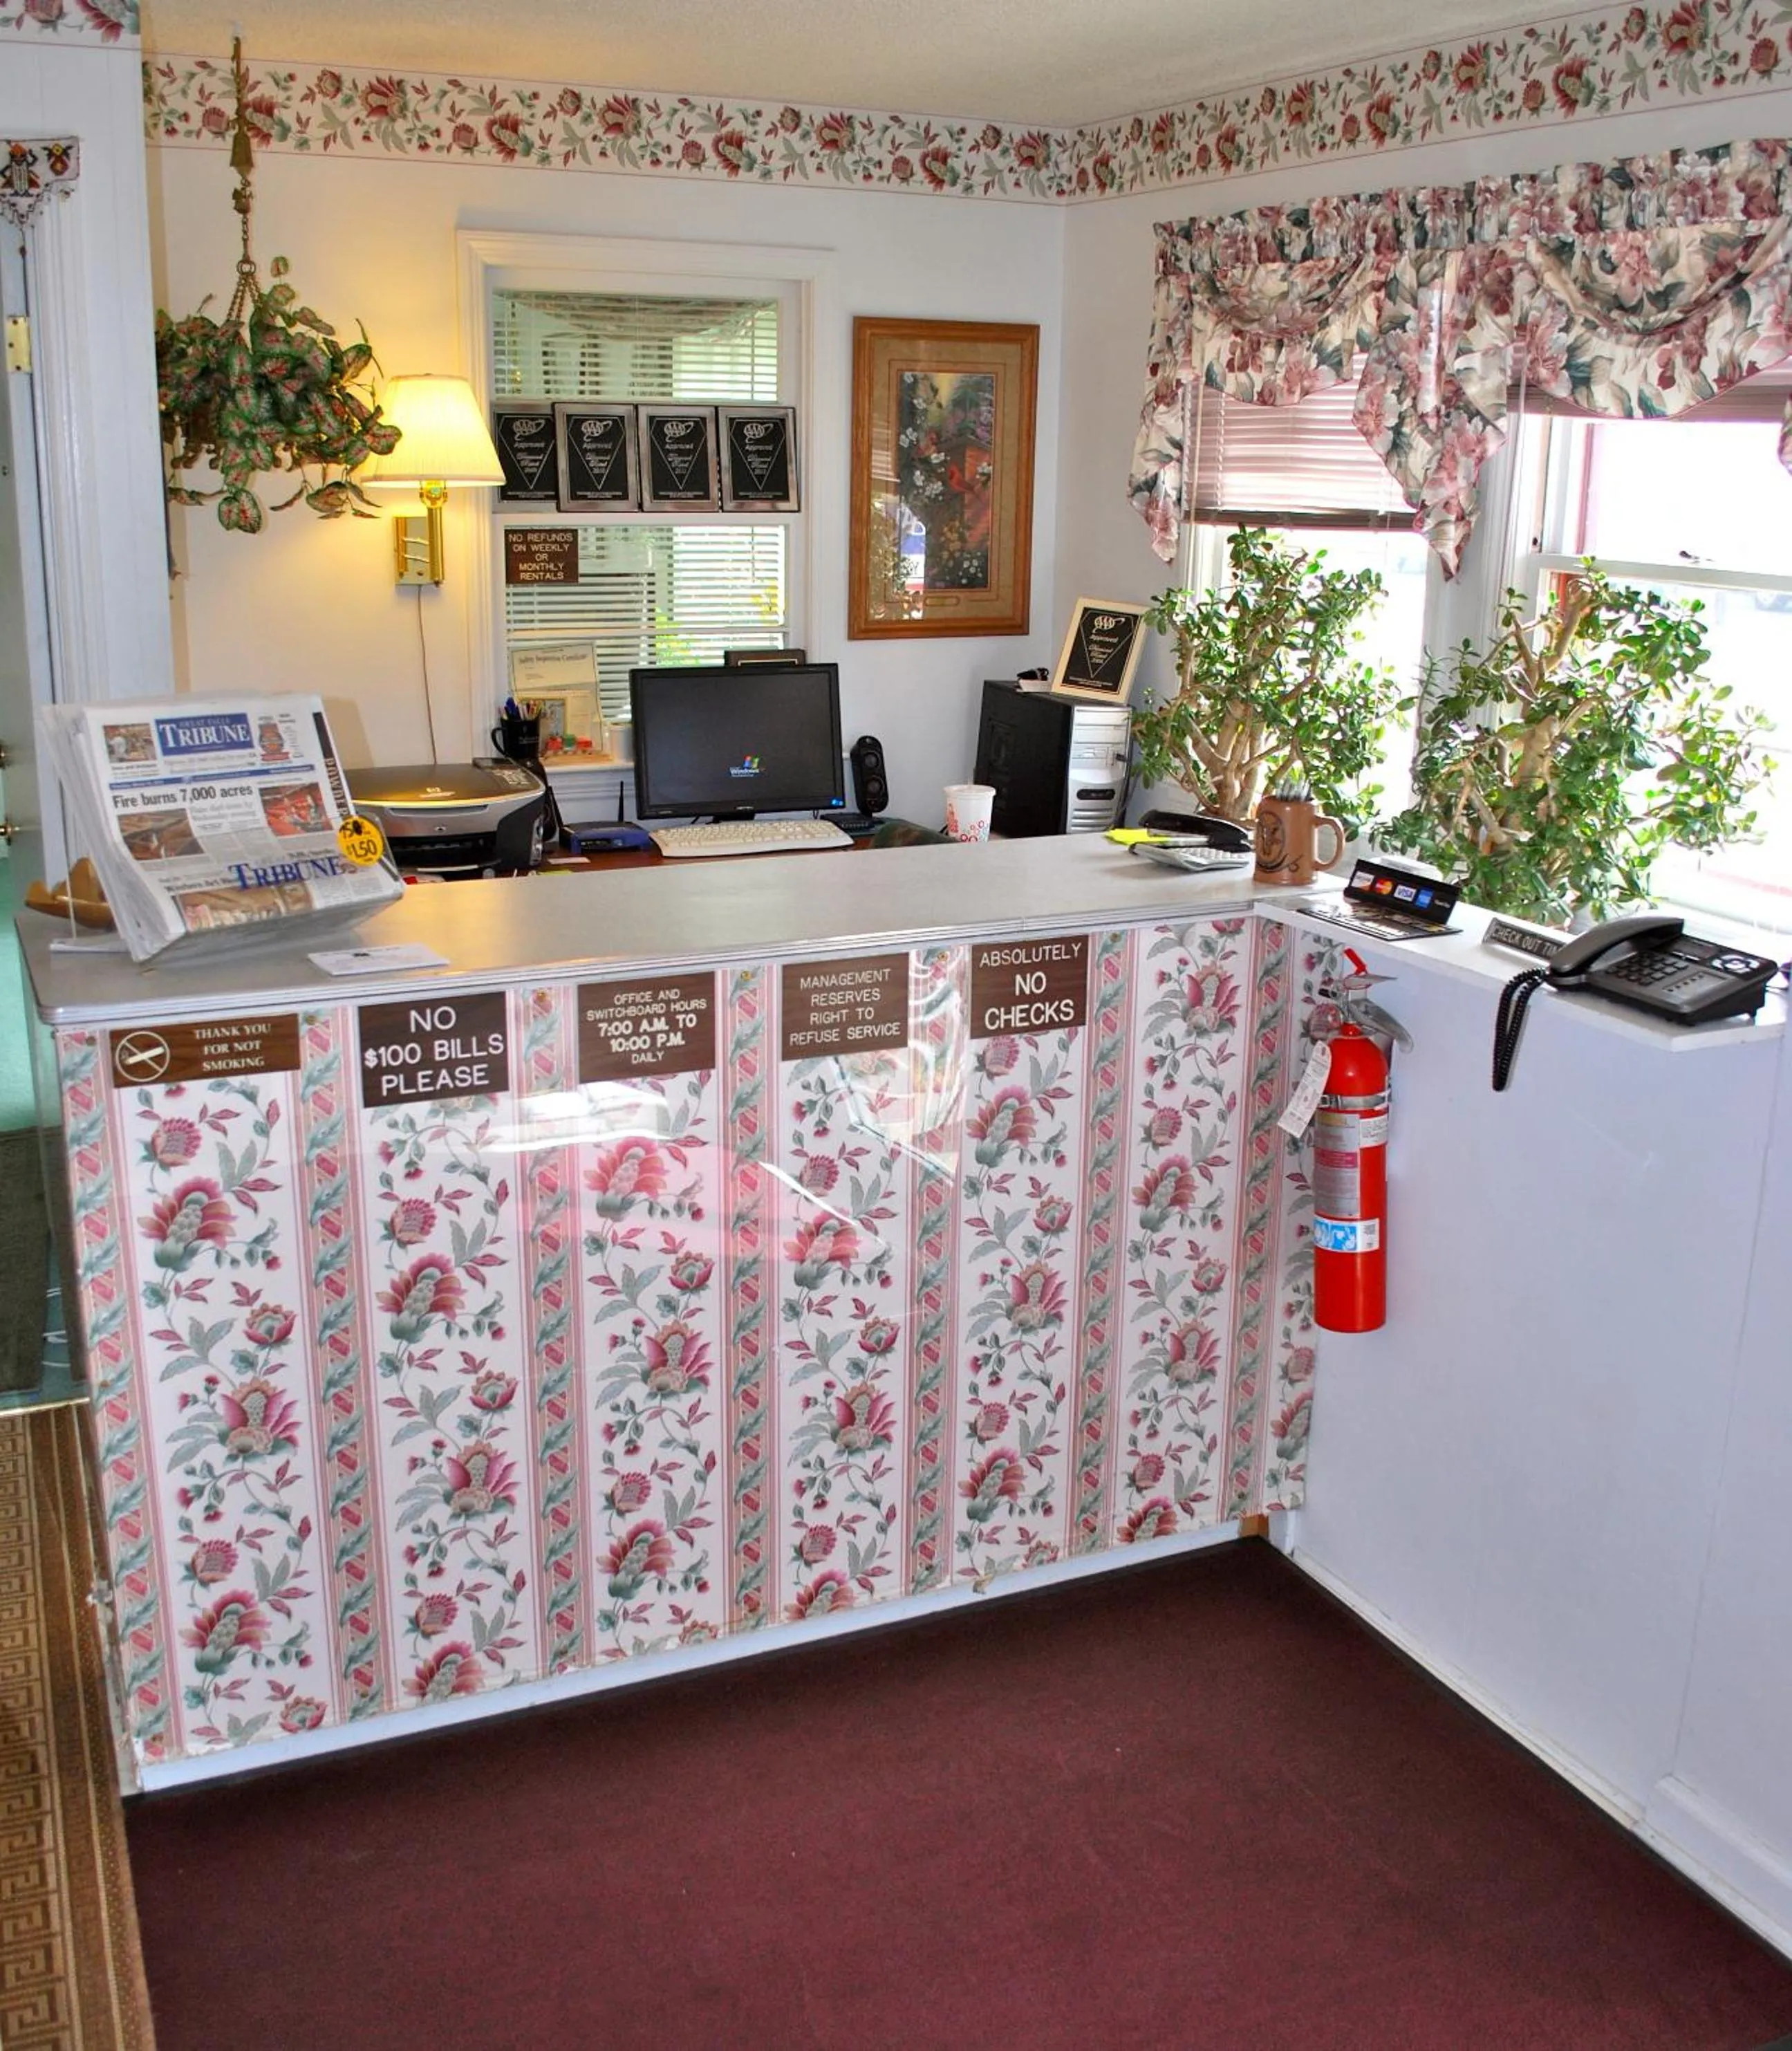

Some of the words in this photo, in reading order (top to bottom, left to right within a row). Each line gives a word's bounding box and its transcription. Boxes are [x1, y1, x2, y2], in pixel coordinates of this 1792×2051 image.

[508, 533, 523, 543] NO
[527, 532, 573, 542] REFUNDS
[512, 544, 527, 552] ON
[530, 543, 570, 552] WEEKLY
[519, 562, 564, 571] MONTHLY
[535, 553, 548, 562] OR
[520, 571, 564, 580] RENTALS
[159, 723, 251, 748] TRIBUNE
[113, 795, 138, 809] Fire
[141, 790, 177, 806] burns
[179, 786, 216, 805] 7,000
[221, 786, 254, 797] acres
[228, 856, 342, 891] TRIBUNE
[1491, 926, 1522, 945] CHECK
[1521, 936, 1543, 952] OUT
[979, 942, 1082, 968] ABSOLUTELY
[799, 968, 891, 992] MANAGEMENT
[1015, 971, 1047, 996] NO
[613, 992, 653, 1005] OFFICE
[657, 988, 680, 1000] AND
[810, 987, 881, 1008] RESERVES
[409, 1005, 457, 1033] NO
[586, 1003, 666, 1021] SWITCHBOARD
[670, 999, 707, 1012] HOURS
[810, 1009, 850, 1026] RIGHT
[855, 1007, 875, 1021] TO
[984, 999, 1074, 1030] CHECKS
[194, 1025, 241, 1040] THANK
[243, 1023, 271, 1036] YOU
[597, 1021, 633, 1037] 7:00
[675, 1013, 697, 1029] TO
[789, 1028, 841, 1046] REFUSE
[846, 1021, 902, 1040] SERVICE
[203, 1042, 230, 1055] FOR
[233, 1040, 261, 1052] NOT
[364, 1043, 422, 1069] $100
[433, 1033, 505, 1061] BILLS
[610, 1034, 651, 1052] 10:00
[202, 1056, 265, 1072] SMOKING
[631, 1050, 664, 1064] DAILY
[381, 1064, 489, 1097] PLEASE
